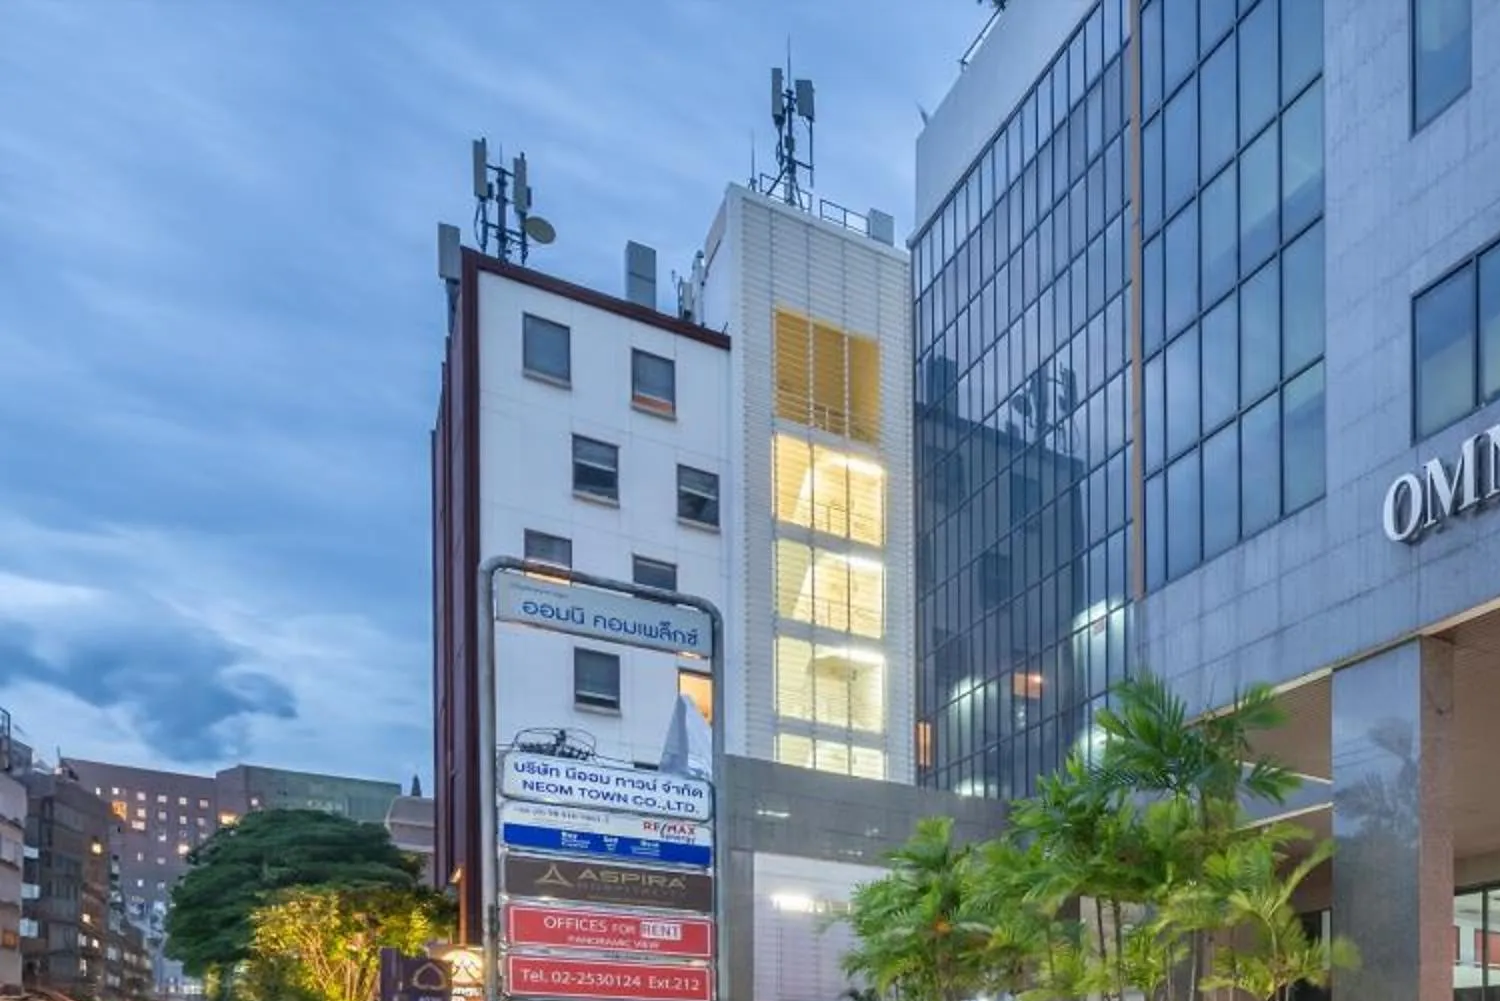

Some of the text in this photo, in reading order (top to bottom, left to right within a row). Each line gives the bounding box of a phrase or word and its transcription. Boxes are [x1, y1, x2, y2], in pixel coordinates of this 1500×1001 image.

[522, 780, 574, 796] NEOM
[577, 787, 629, 804] TOWN
[577, 868, 687, 889] ASPIRA
[543, 916, 608, 934] OFFICES
[611, 923, 637, 935] FOR
[520, 968, 548, 983] Tel.
[551, 970, 642, 988] 02-2530124
